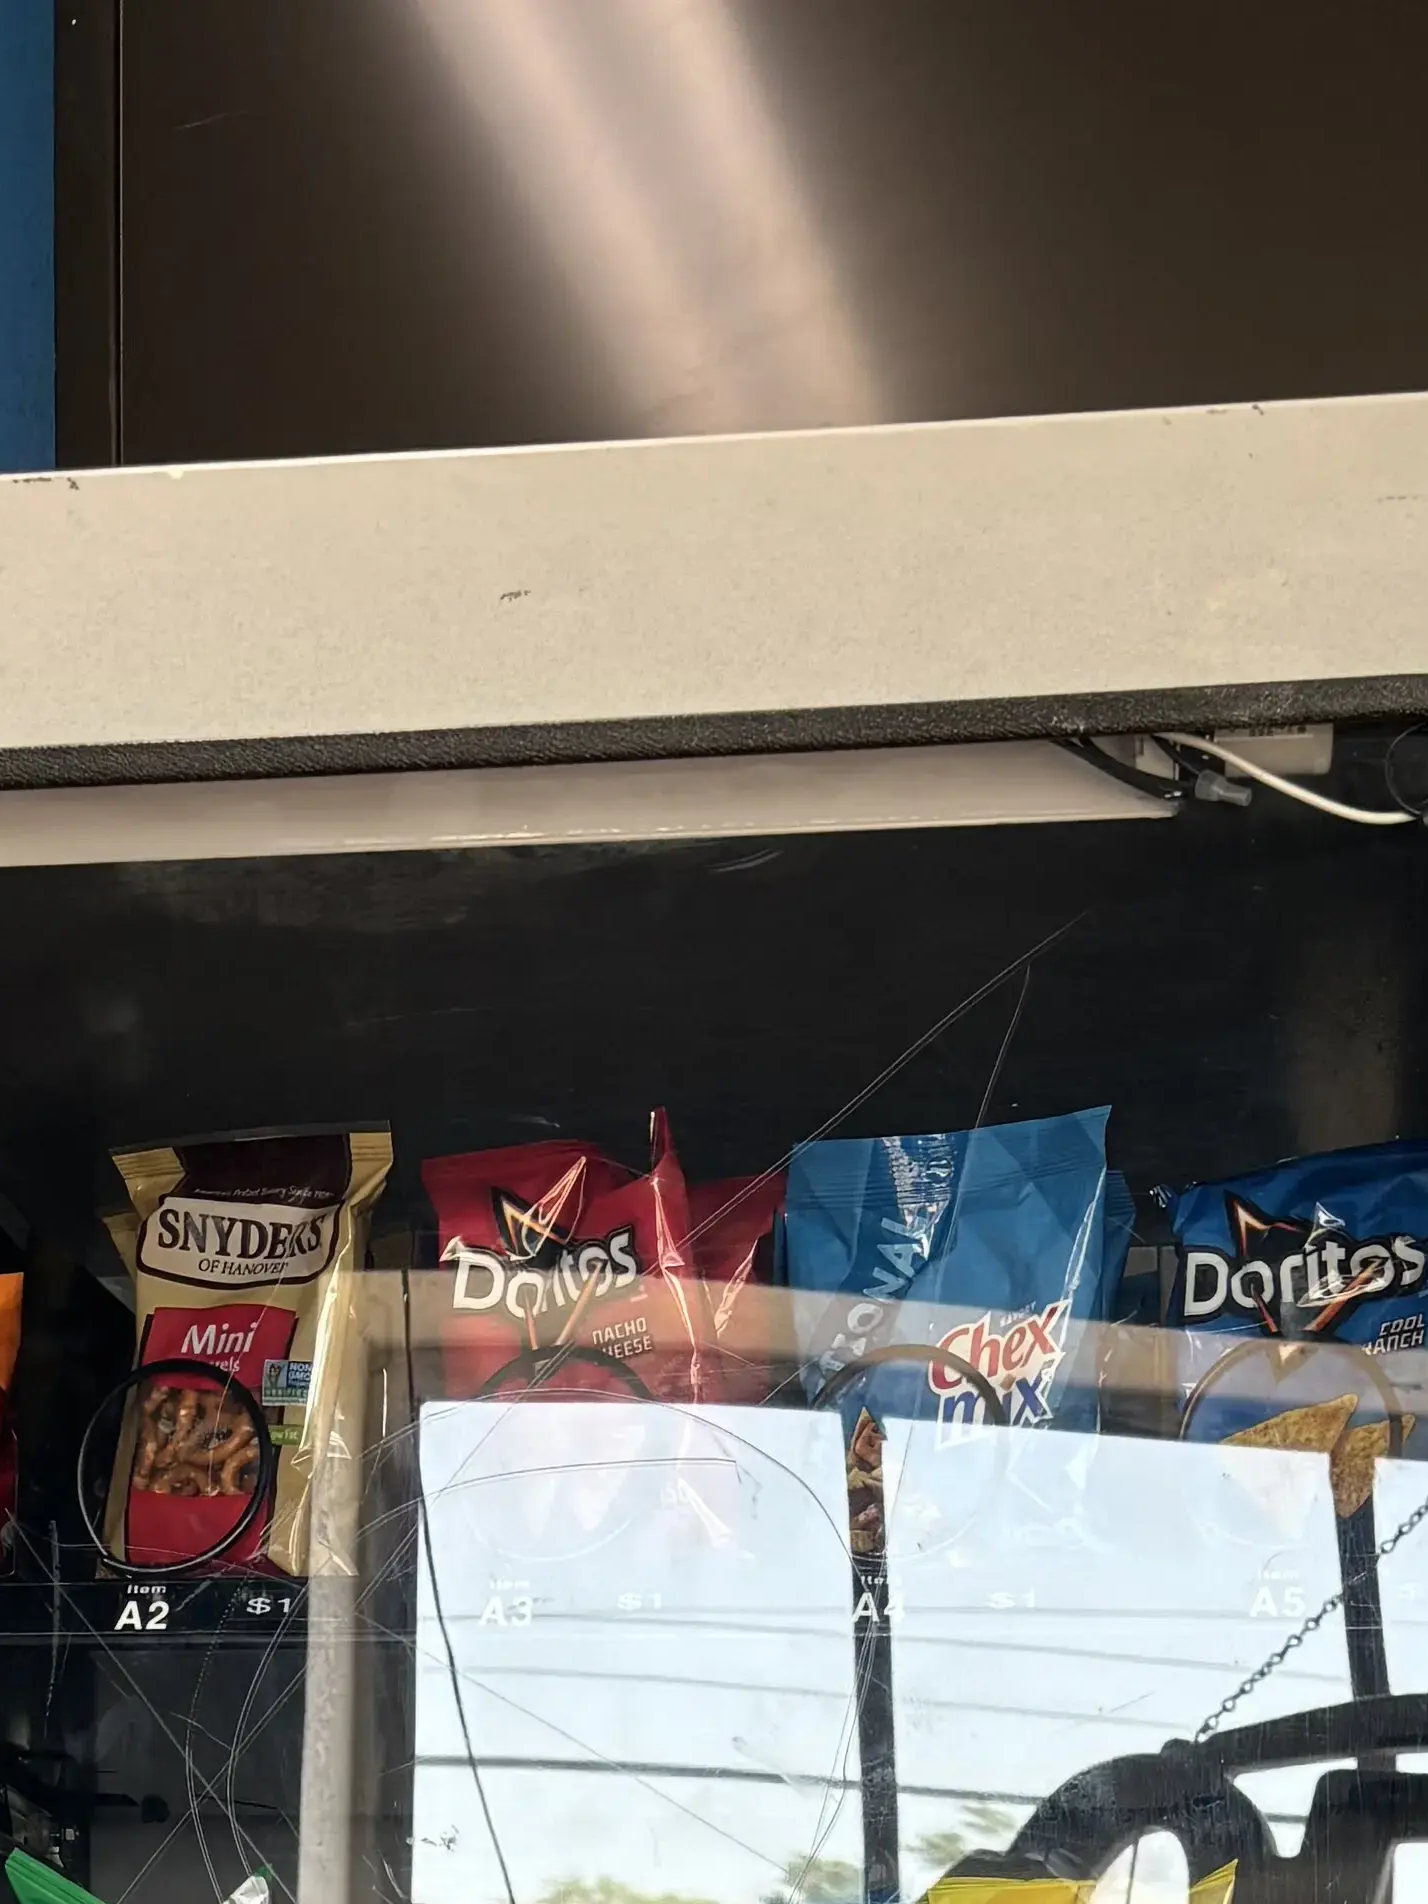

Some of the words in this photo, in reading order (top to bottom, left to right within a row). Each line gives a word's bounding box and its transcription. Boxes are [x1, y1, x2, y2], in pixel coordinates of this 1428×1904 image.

[199, 1259, 218, 1273] OF
[453, 1227, 637, 1320] Doritos
[1184, 1237, 1426, 1318] Doritos
[181, 1322, 258, 1356] Mini
[592, 1317, 647, 1343] NACHO
[1378, 1313, 1425, 1337] COOL
[930, 1306, 1058, 1391] Chex
[114, 1602, 170, 1630] A2
[246, 1597, 292, 1615] $1
[479, 1596, 534, 1627] A3
[851, 1591, 906, 1624] A4
[1250, 1588, 1307, 1618] A5
